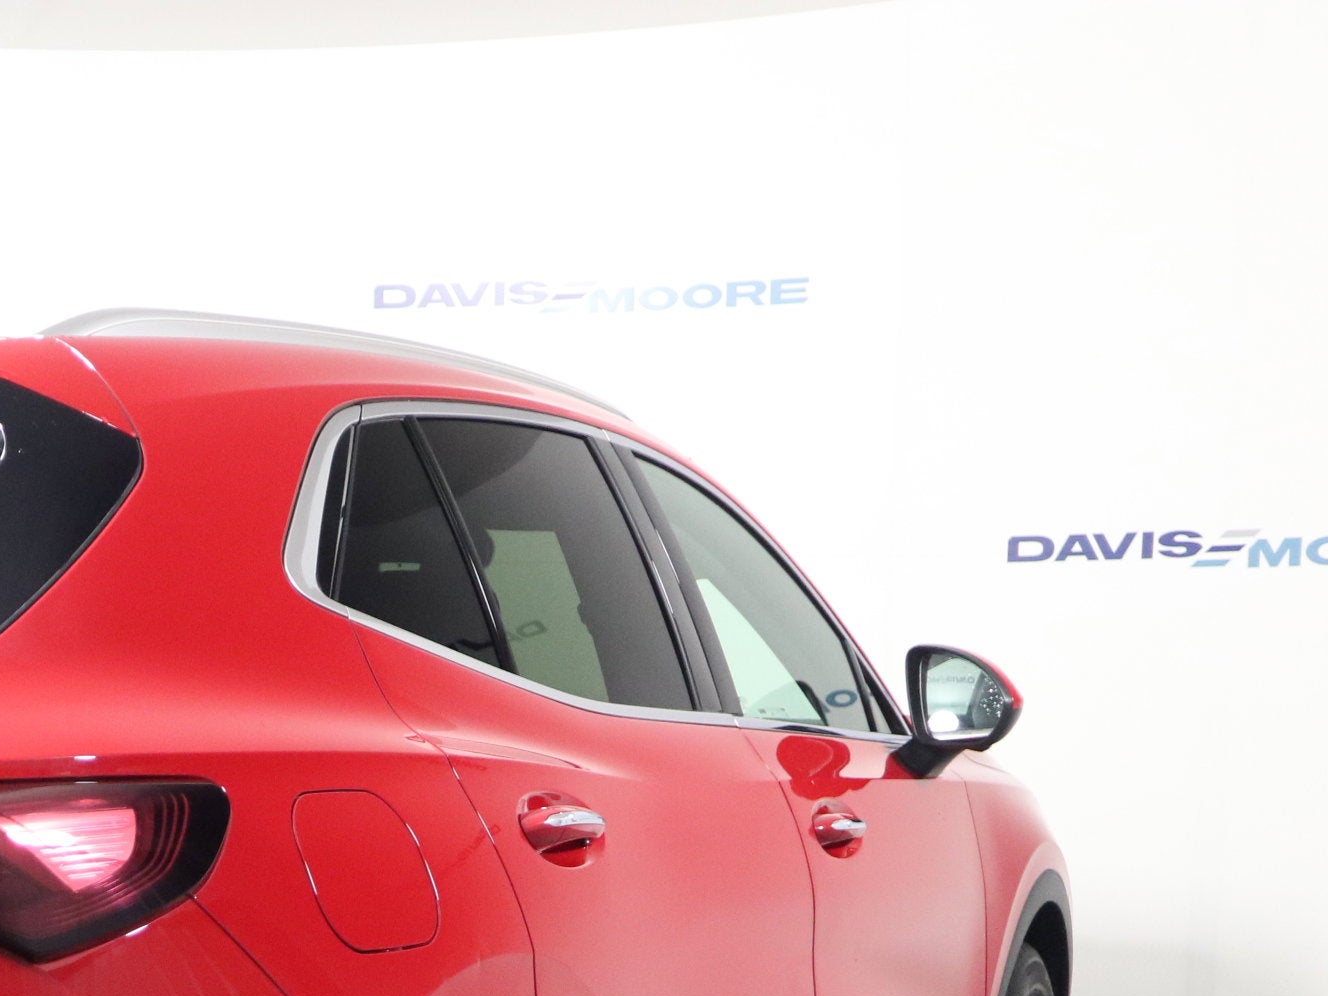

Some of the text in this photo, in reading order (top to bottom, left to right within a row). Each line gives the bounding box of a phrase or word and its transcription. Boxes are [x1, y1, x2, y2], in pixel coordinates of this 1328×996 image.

[373, 277, 810, 313] DAVIS MOORE
[1007, 529, 1203, 563] DAVIS
